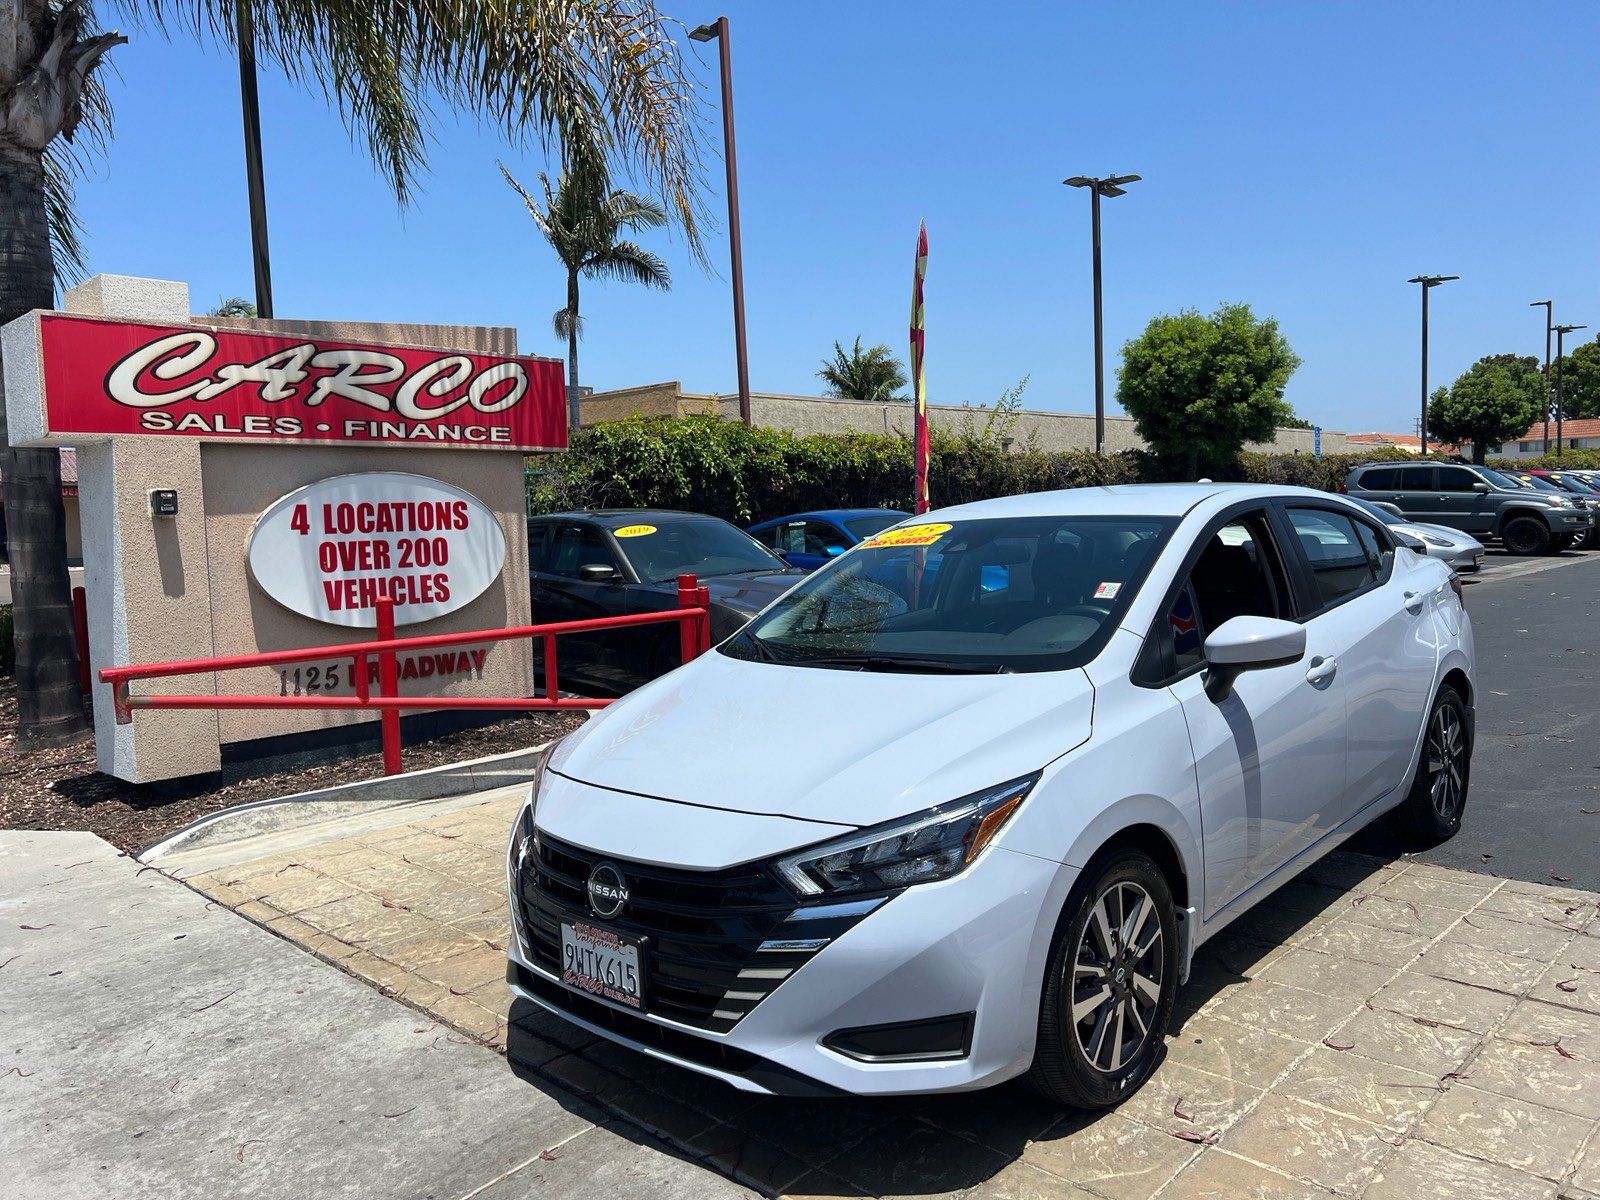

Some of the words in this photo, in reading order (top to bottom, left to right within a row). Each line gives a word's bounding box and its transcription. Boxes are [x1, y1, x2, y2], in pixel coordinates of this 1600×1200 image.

[103, 331, 528, 420] CARCO
[140, 410, 303, 436] SALES
[343, 419, 512, 443] FINANCE
[290, 504, 311, 536] 4
[323, 501, 469, 535] LOCATIONS
[318, 539, 391, 573] OVER
[397, 537, 449, 568] 200
[323, 573, 451, 611] VEHICLES
[279, 664, 340, 697] 1125
[348, 649, 488, 688] RADWAY
[588, 881, 629, 900] NISSAN
[564, 943, 638, 995] 9WTK615
